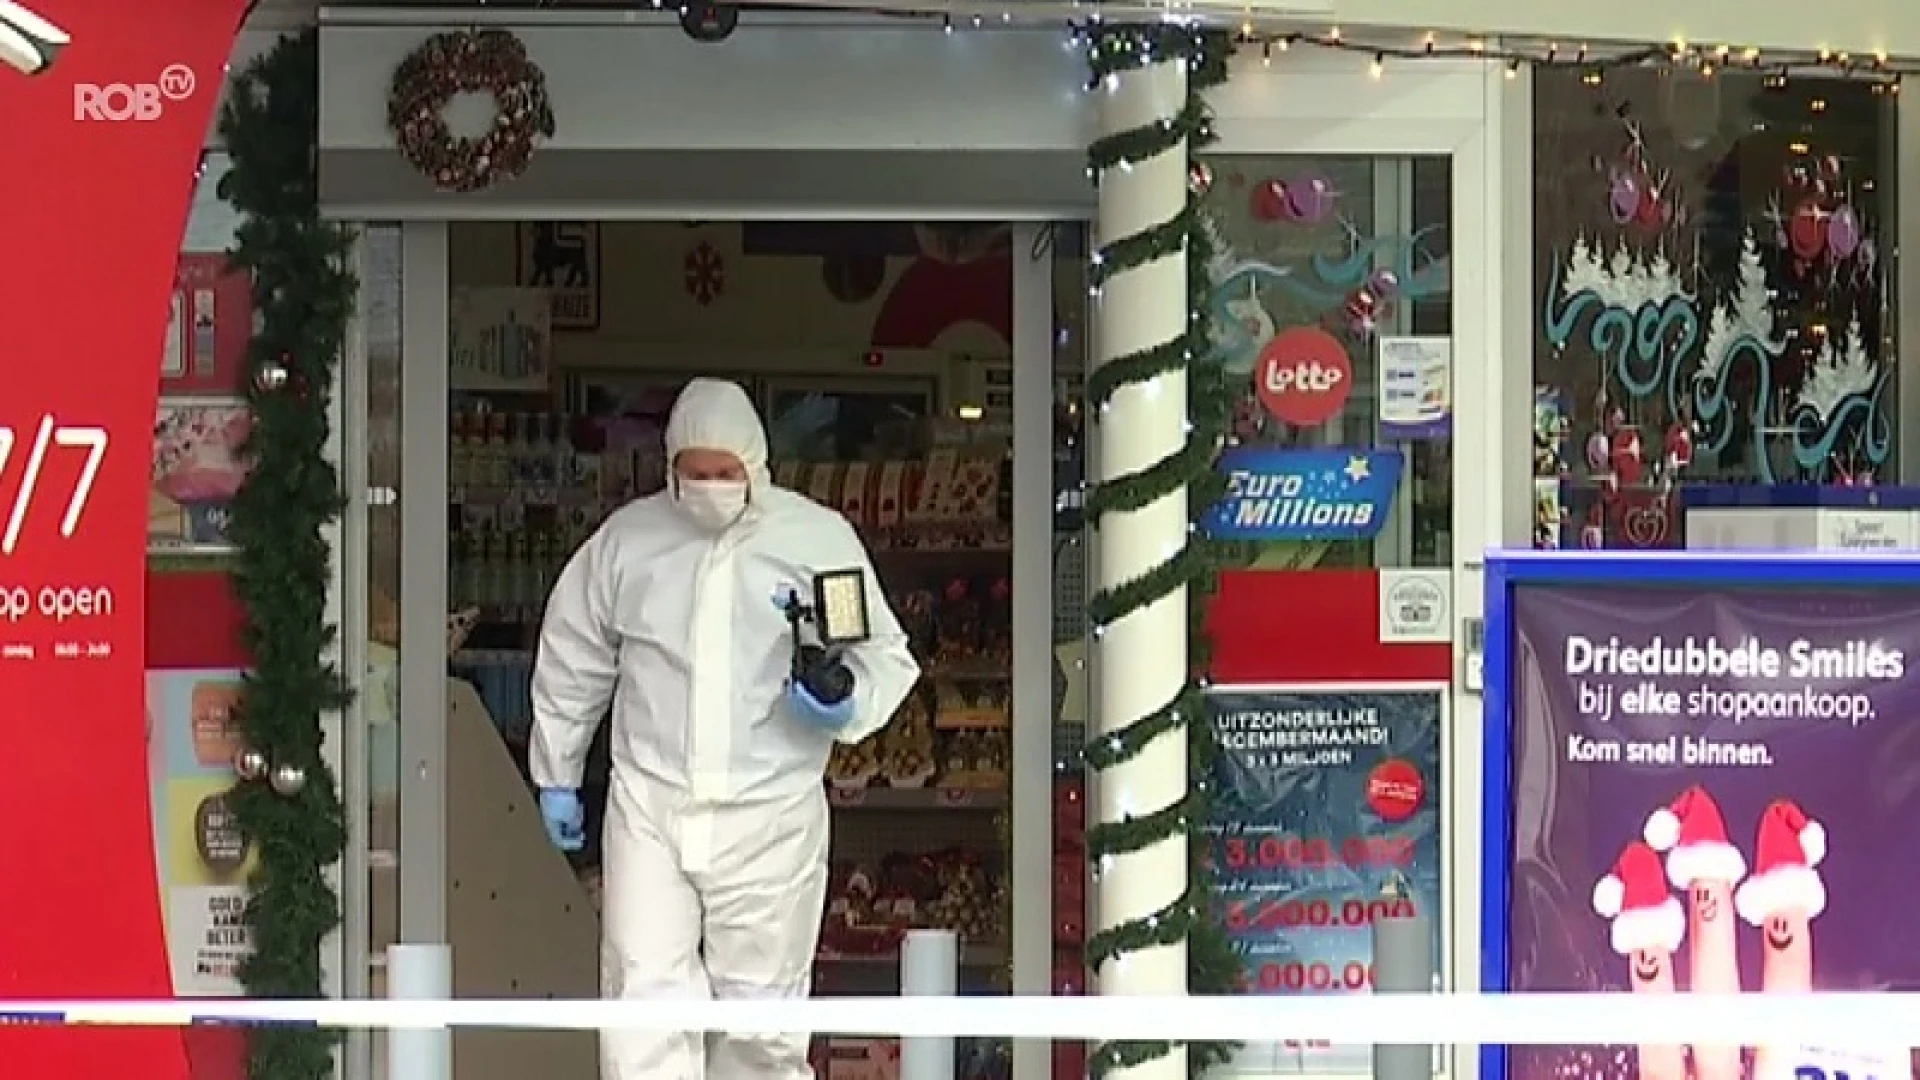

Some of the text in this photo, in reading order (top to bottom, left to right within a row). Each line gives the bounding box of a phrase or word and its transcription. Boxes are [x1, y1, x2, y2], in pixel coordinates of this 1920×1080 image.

[1266, 358, 1343, 393] Lotto
[0, 413, 108, 556] /7
[1227, 469, 1303, 498] Euro
[1234, 496, 1374, 528] Millions
[38, 584, 112, 623] open
[1566, 634, 1904, 680] Driedubbele Smiles
[1217, 707, 1380, 731] UITZONDERLIJKE
[1578, 680, 1876, 727] bij elke shopaankoop.
[1567, 732, 1774, 766] Kom snel binnen.
